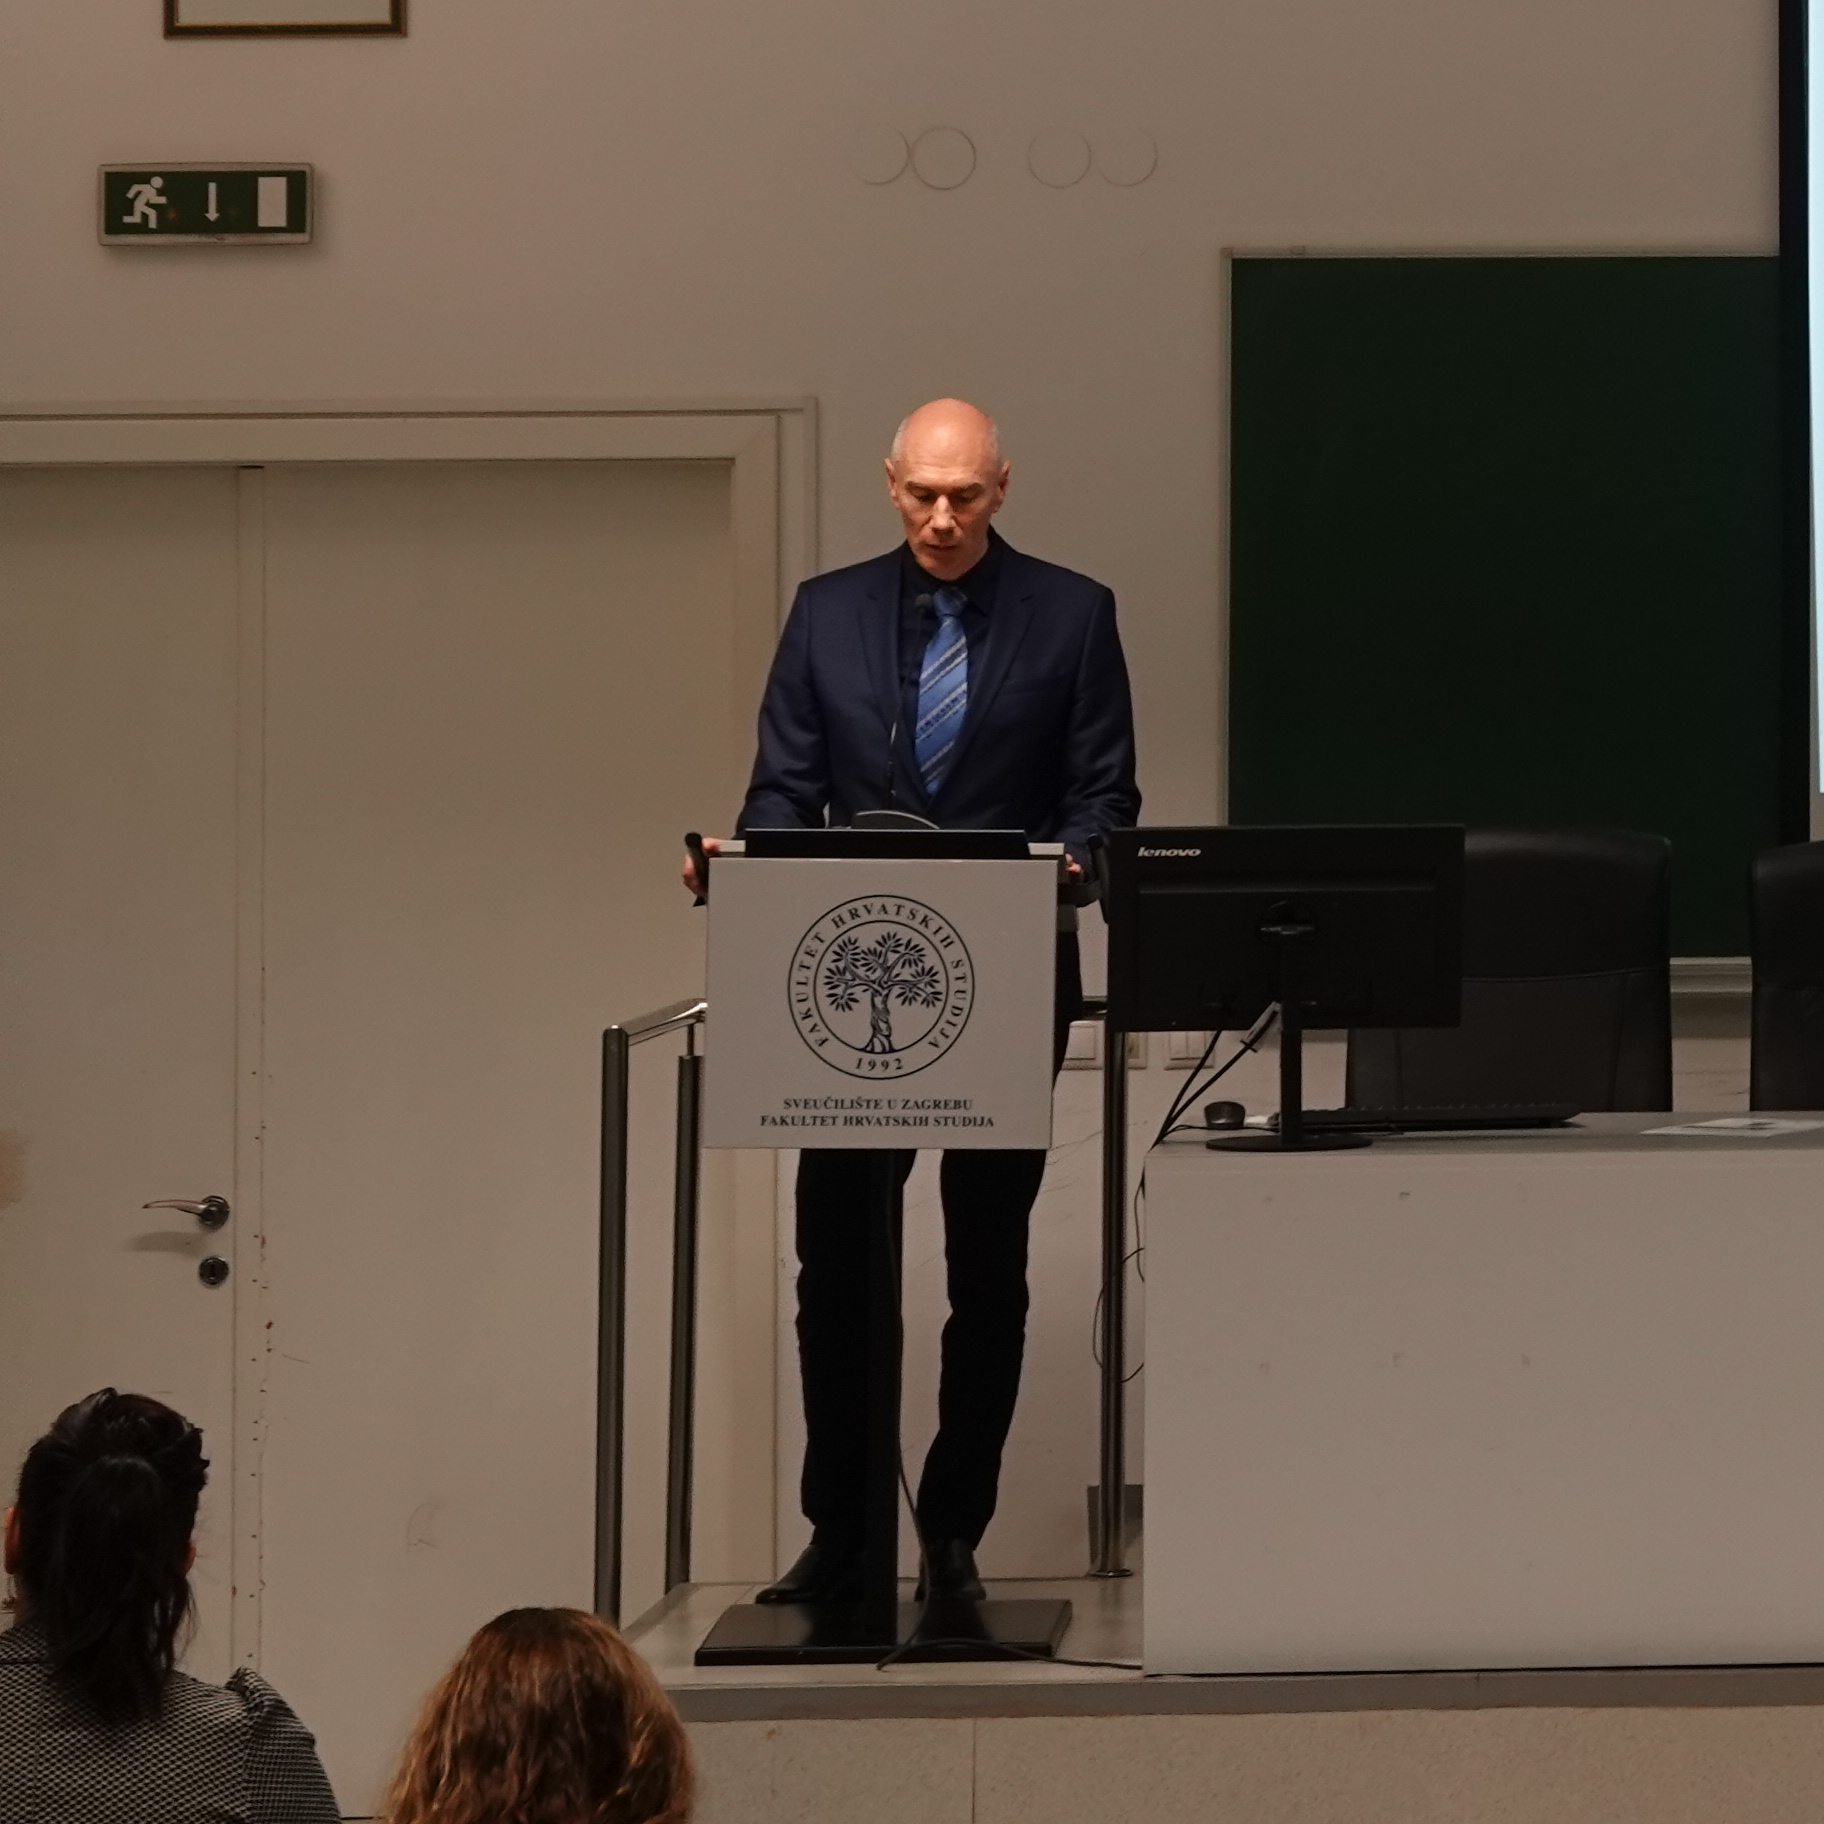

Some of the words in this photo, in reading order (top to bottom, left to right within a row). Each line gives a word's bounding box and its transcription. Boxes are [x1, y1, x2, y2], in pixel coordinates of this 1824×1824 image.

[1138, 847, 1201, 857] lenovo
[795, 931, 829, 1048] FAKULTET
[831, 903, 955, 949] HRVATSKIH
[928, 958, 967, 1050] STUDIJA
[855, 1057, 903, 1071] 1992
[887, 1098, 897, 1110] U
[901, 1098, 973, 1110] ZAGREBU
[760, 1115, 839, 1126] FAKULTET
[843, 1115, 930, 1126] HRVATSKIH
[933, 1115, 995, 1126] STUDIJA
